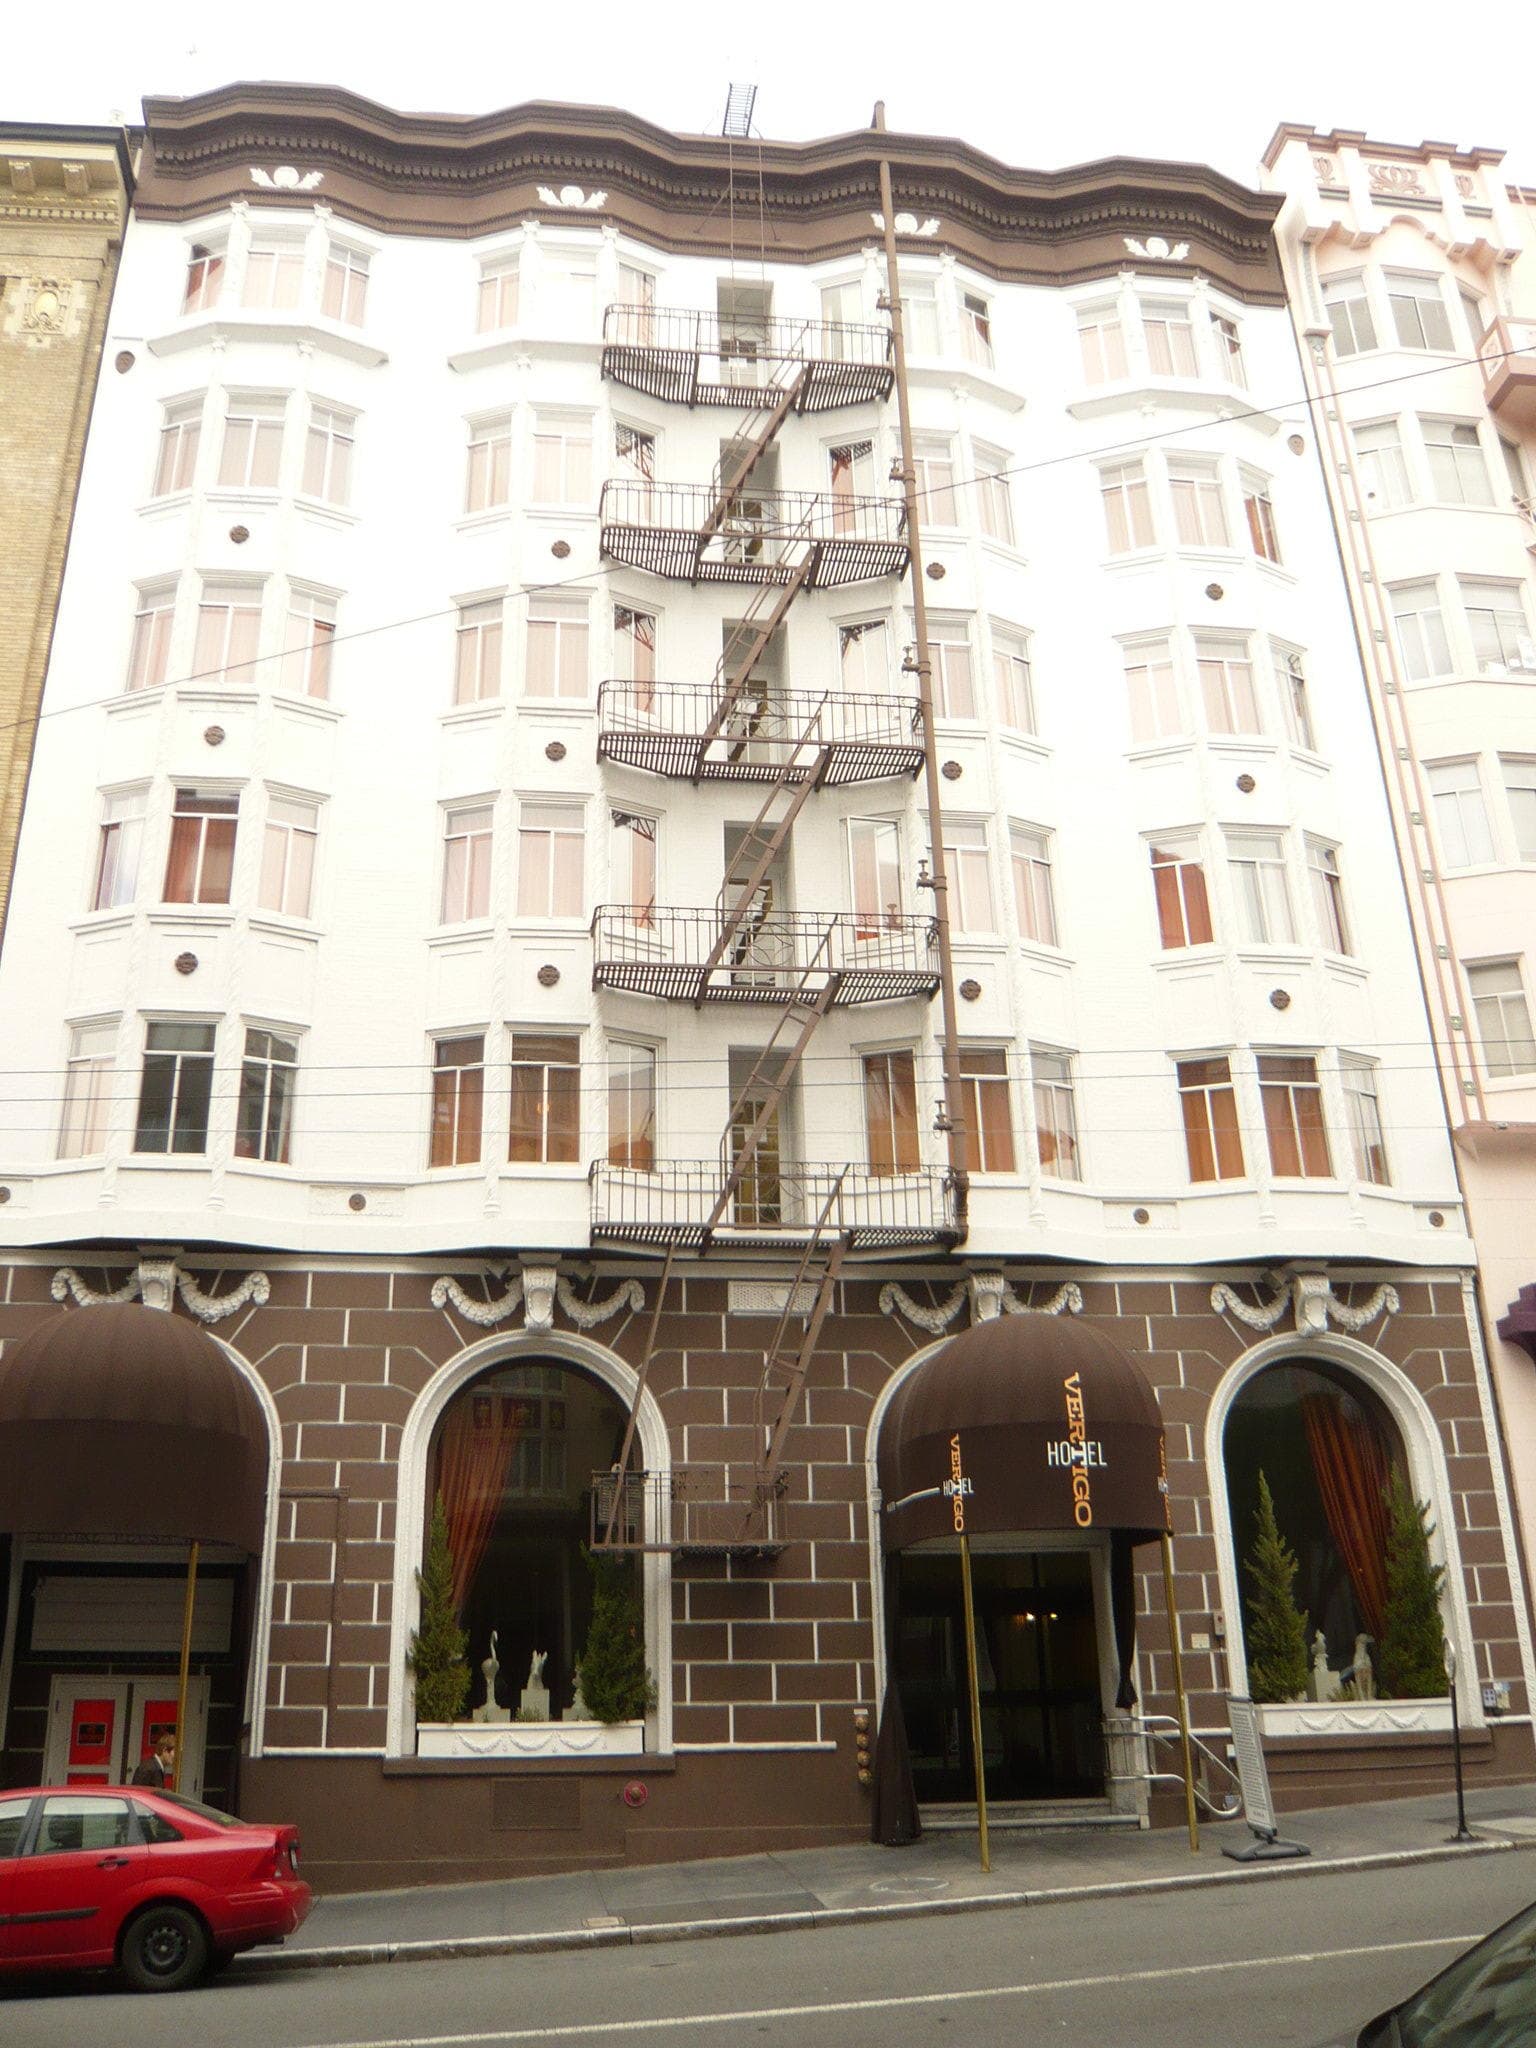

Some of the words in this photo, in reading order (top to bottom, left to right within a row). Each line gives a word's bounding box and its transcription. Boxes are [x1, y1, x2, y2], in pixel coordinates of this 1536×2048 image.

[1047, 1441, 1107, 1466] HOTEL
[1064, 1372, 1092, 1527] VERTIGO
[943, 1477, 974, 1496] HOTEL
[951, 1433, 964, 1532] VERTIGO
